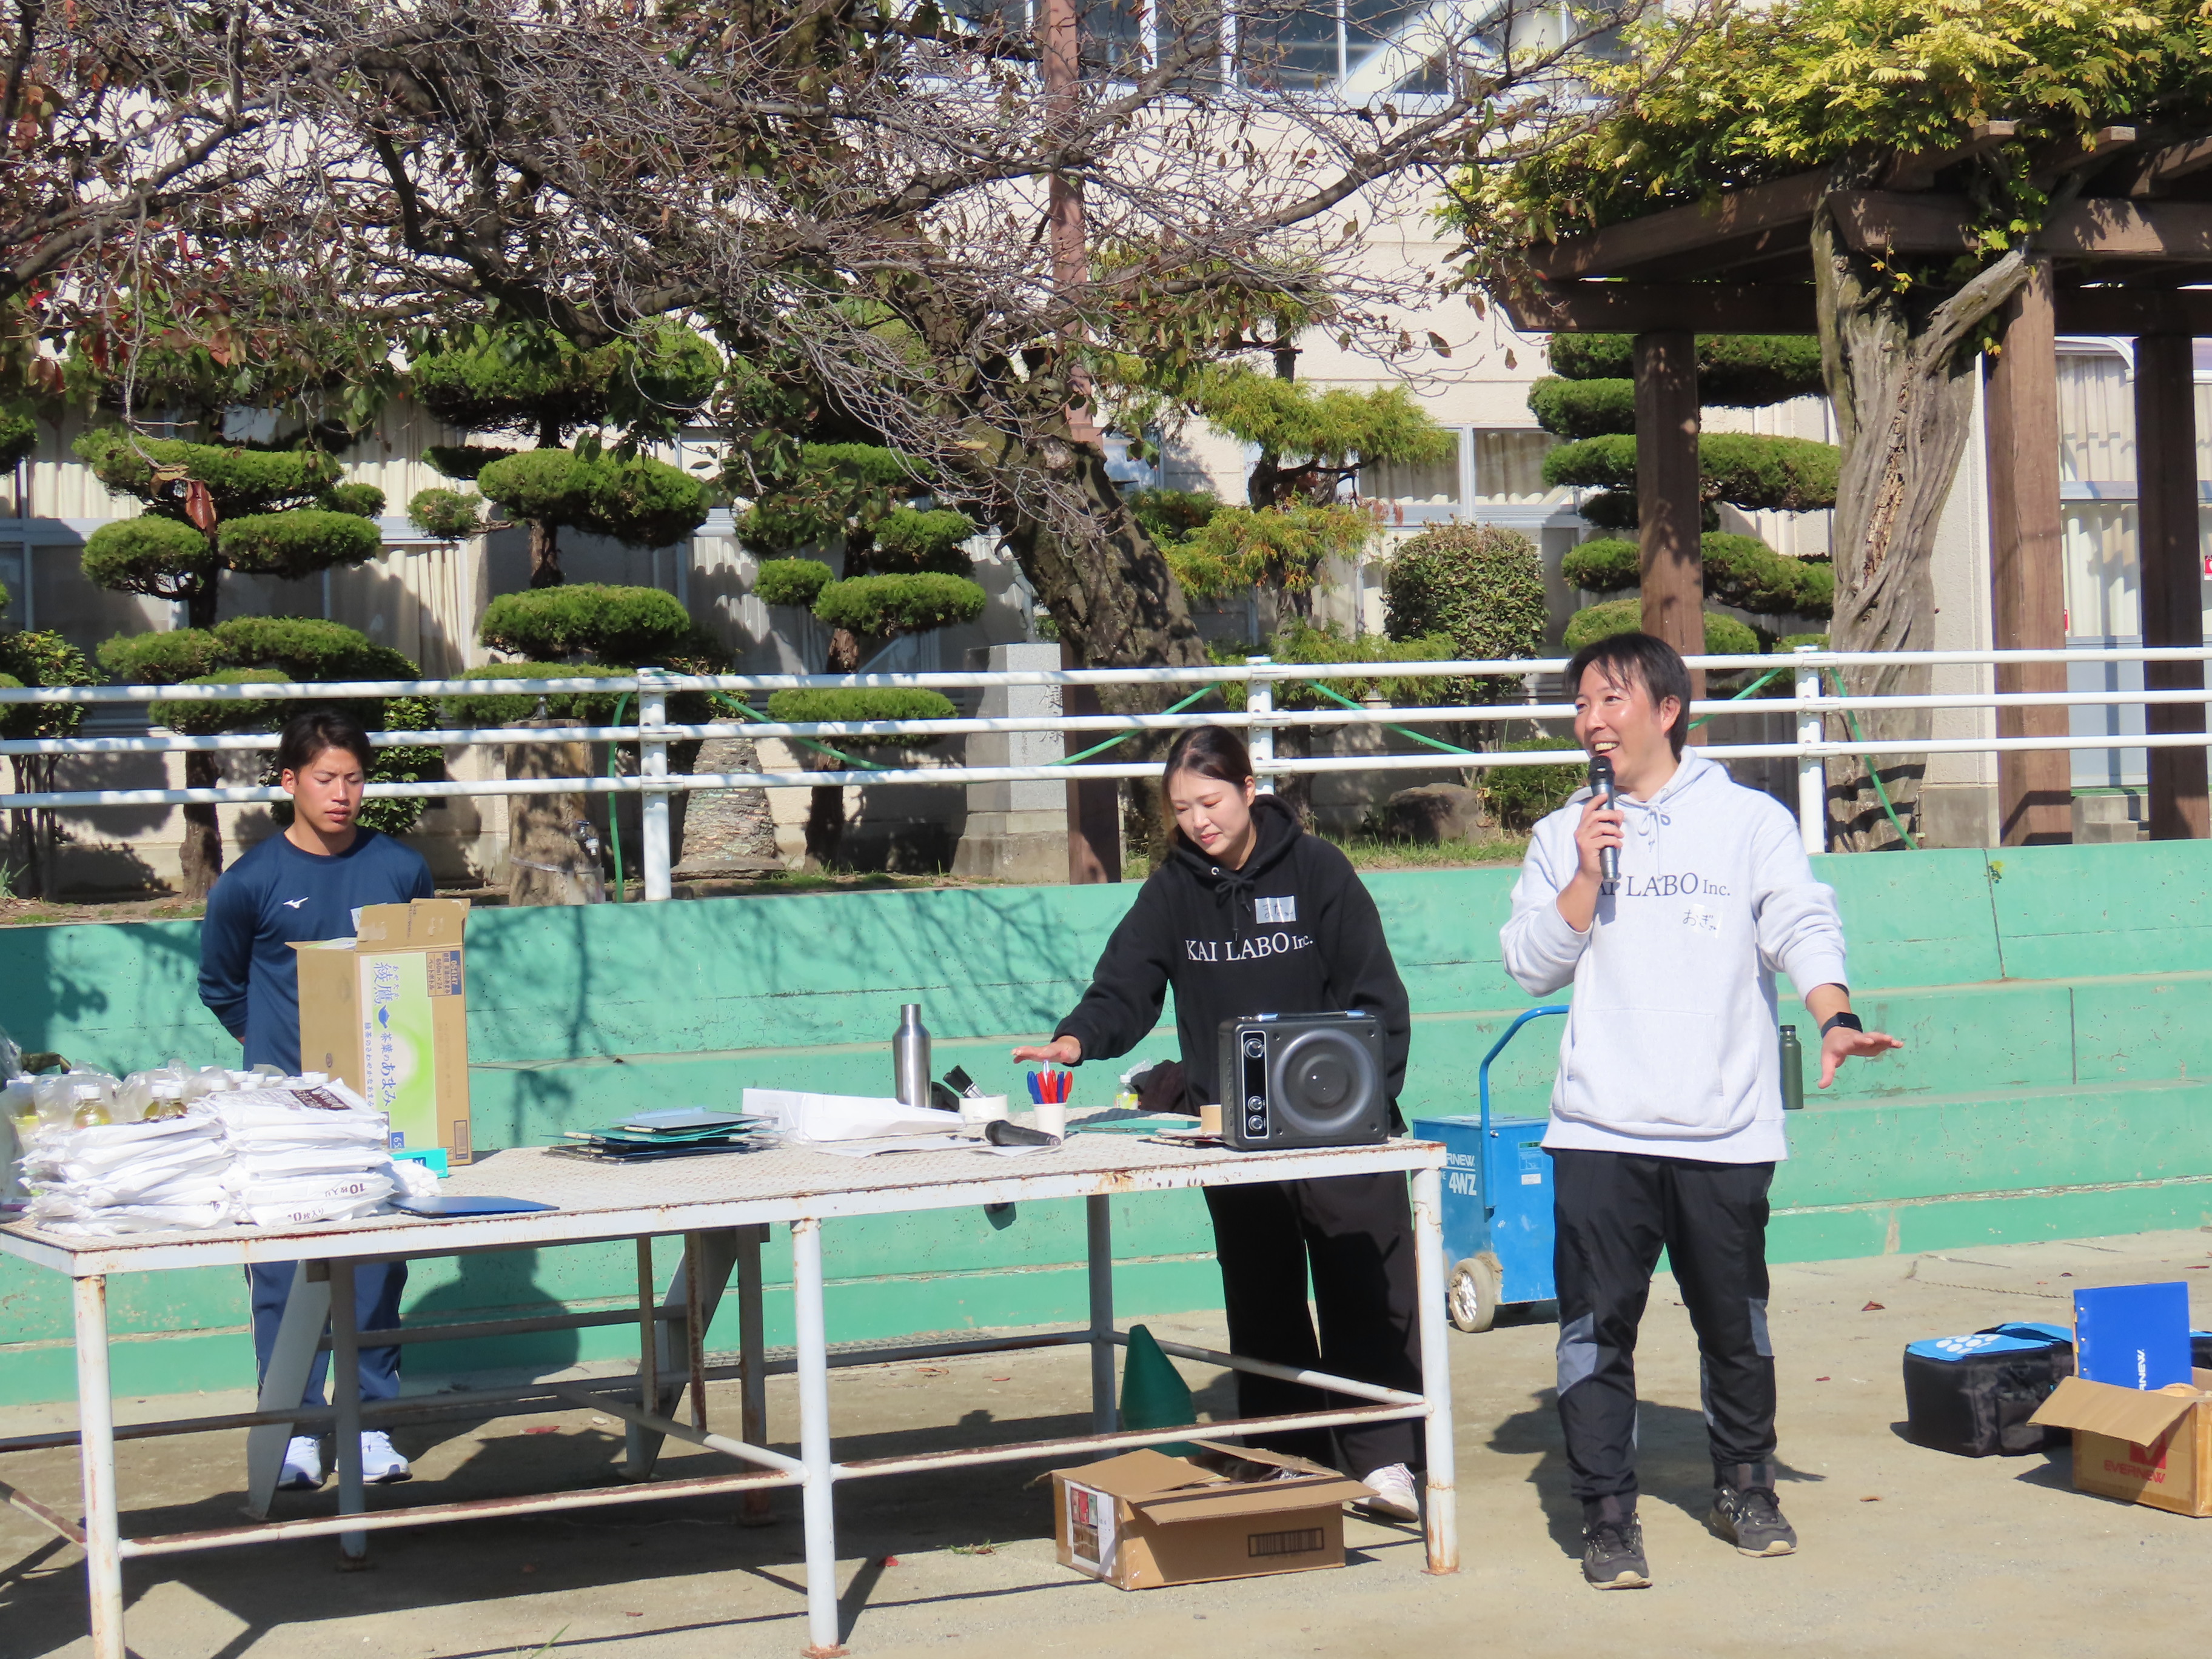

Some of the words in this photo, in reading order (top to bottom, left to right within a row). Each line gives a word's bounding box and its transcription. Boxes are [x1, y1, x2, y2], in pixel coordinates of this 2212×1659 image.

[1626, 873, 1698, 896] LABO
[1703, 879, 1730, 896] Inc.
[1185, 939, 1218, 962] KAI
[1225, 932, 1289, 960] LABO
[1292, 934, 1313, 951] Inc.
[373, 961, 393, 1006] 綾鷹
[380, 1032, 397, 1107] 茶葉のあまみ
[1447, 1153, 1475, 1167] RNEW
[1449, 1172, 1477, 1196] 4WZ
[2137, 1349, 2147, 1390] RNEW
[2104, 1461, 2165, 1483] EVERNEW
